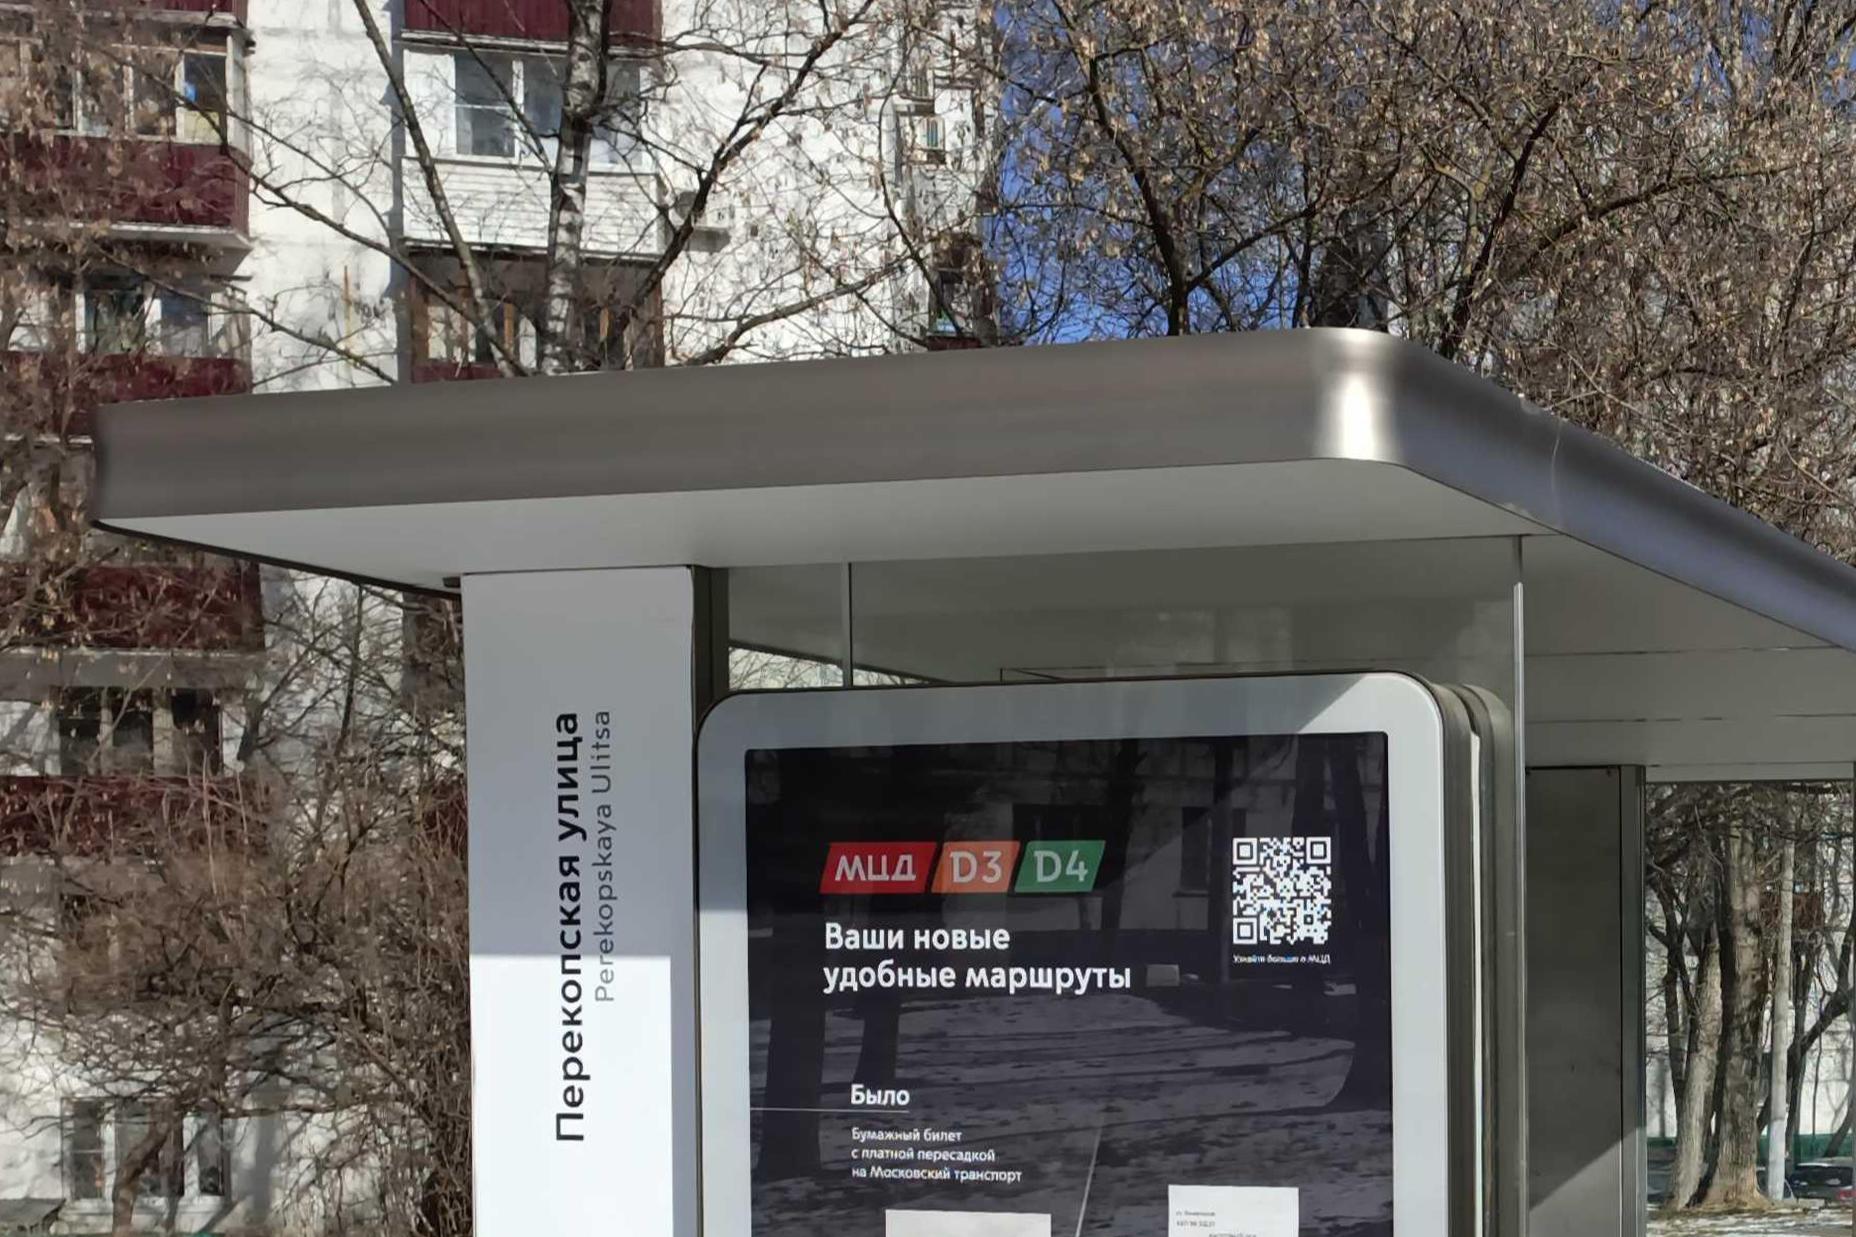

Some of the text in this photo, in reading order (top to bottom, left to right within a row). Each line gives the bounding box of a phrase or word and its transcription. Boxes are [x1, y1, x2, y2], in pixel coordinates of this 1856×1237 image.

[590, 711, 618, 1003] Perekopskaya Ulitsa
[834, 849, 1089, 884] МЦД D3 D4
[555, 712, 591, 1141] Перекопская улица
[825, 921, 1011, 950] Ваши новые
[822, 958, 1132, 996] удобные маршруты
[850, 1083, 910, 1106] Было
[851, 1126, 963, 1143] Бумажный билет
[851, 1147, 996, 1163] с платной пересадкой
[851, 1165, 1023, 1184] на Московский транспорт
